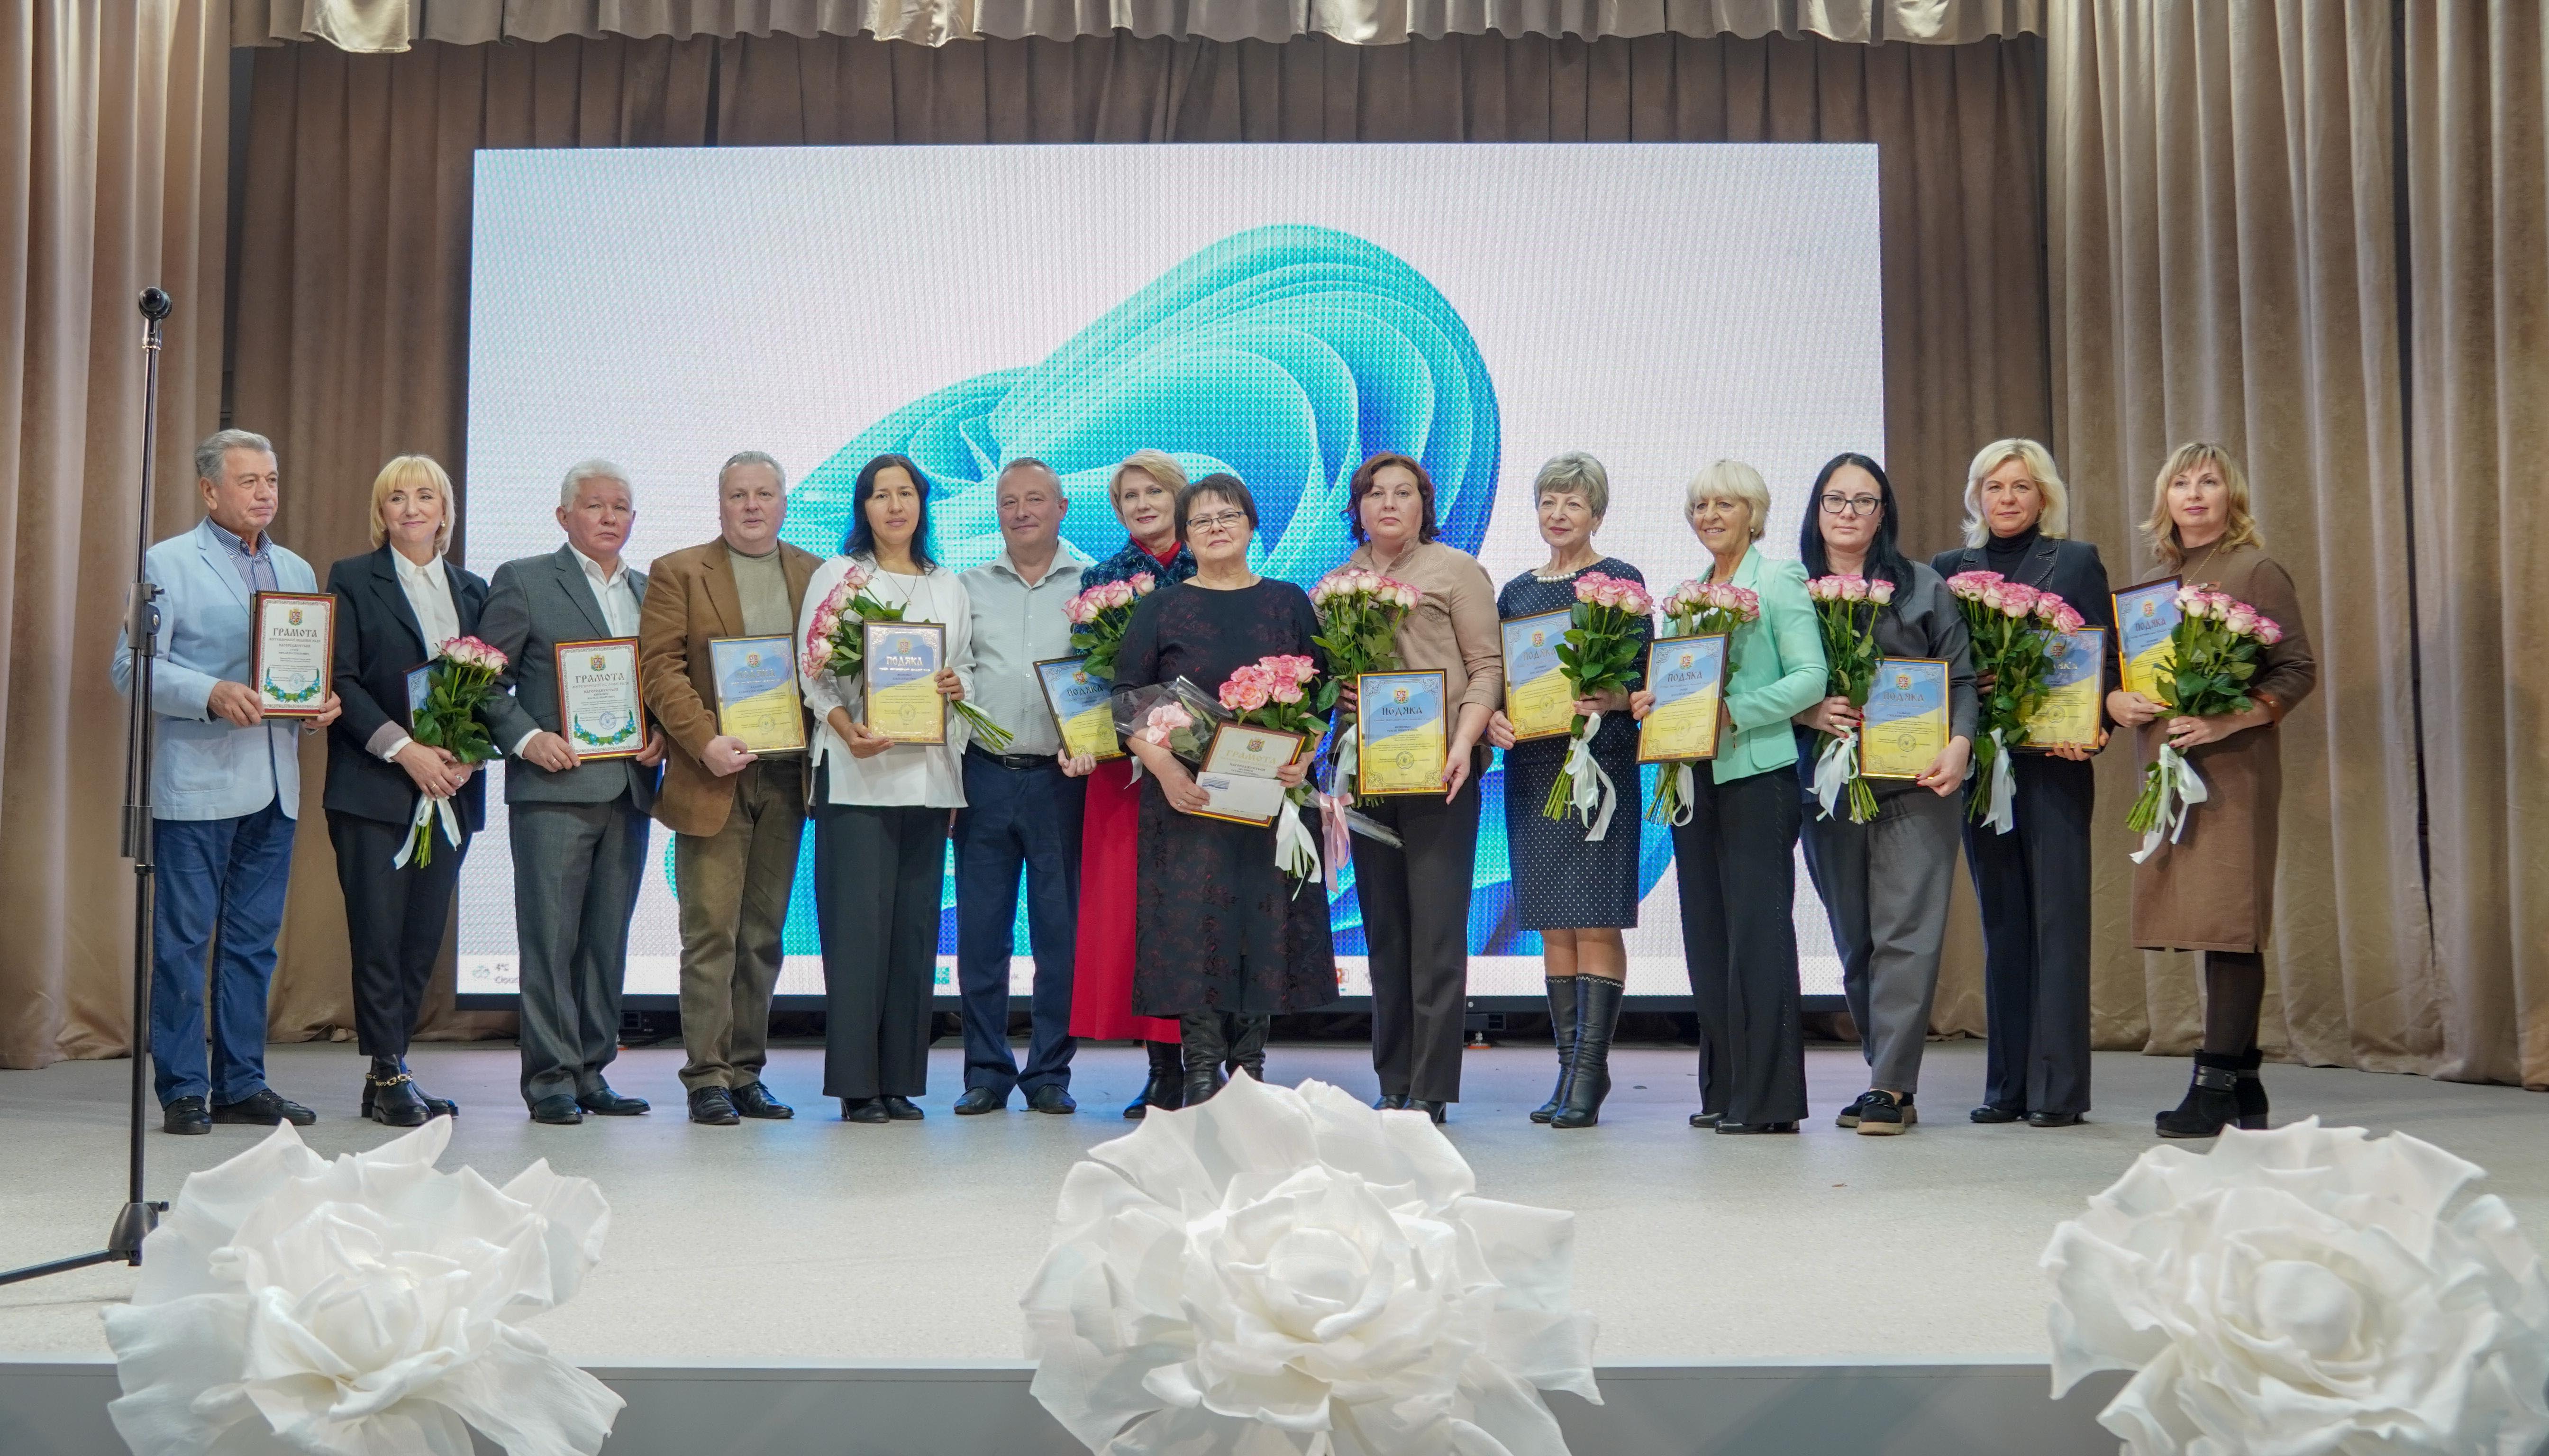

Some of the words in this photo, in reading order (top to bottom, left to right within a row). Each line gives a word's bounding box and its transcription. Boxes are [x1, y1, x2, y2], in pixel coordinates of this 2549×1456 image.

[2135, 618, 2167, 632] ПОДЯКА
[273, 628, 318, 637] ГРАМОТА
[1523, 647, 1557, 661] ПОДЯКА
[886, 656, 923, 666] ПОДЯКА
[575, 673, 625, 683] ГРАМОТА
[1668, 671, 1702, 682] ПОДЯКА
[1067, 685, 1104, 697] ПОДЯКА
[1883, 692, 1924, 702] ПОДЯКА
[1382, 707, 1422, 716] ПОДЯКА
[1226, 750, 1276, 764] ГРАМОТА
